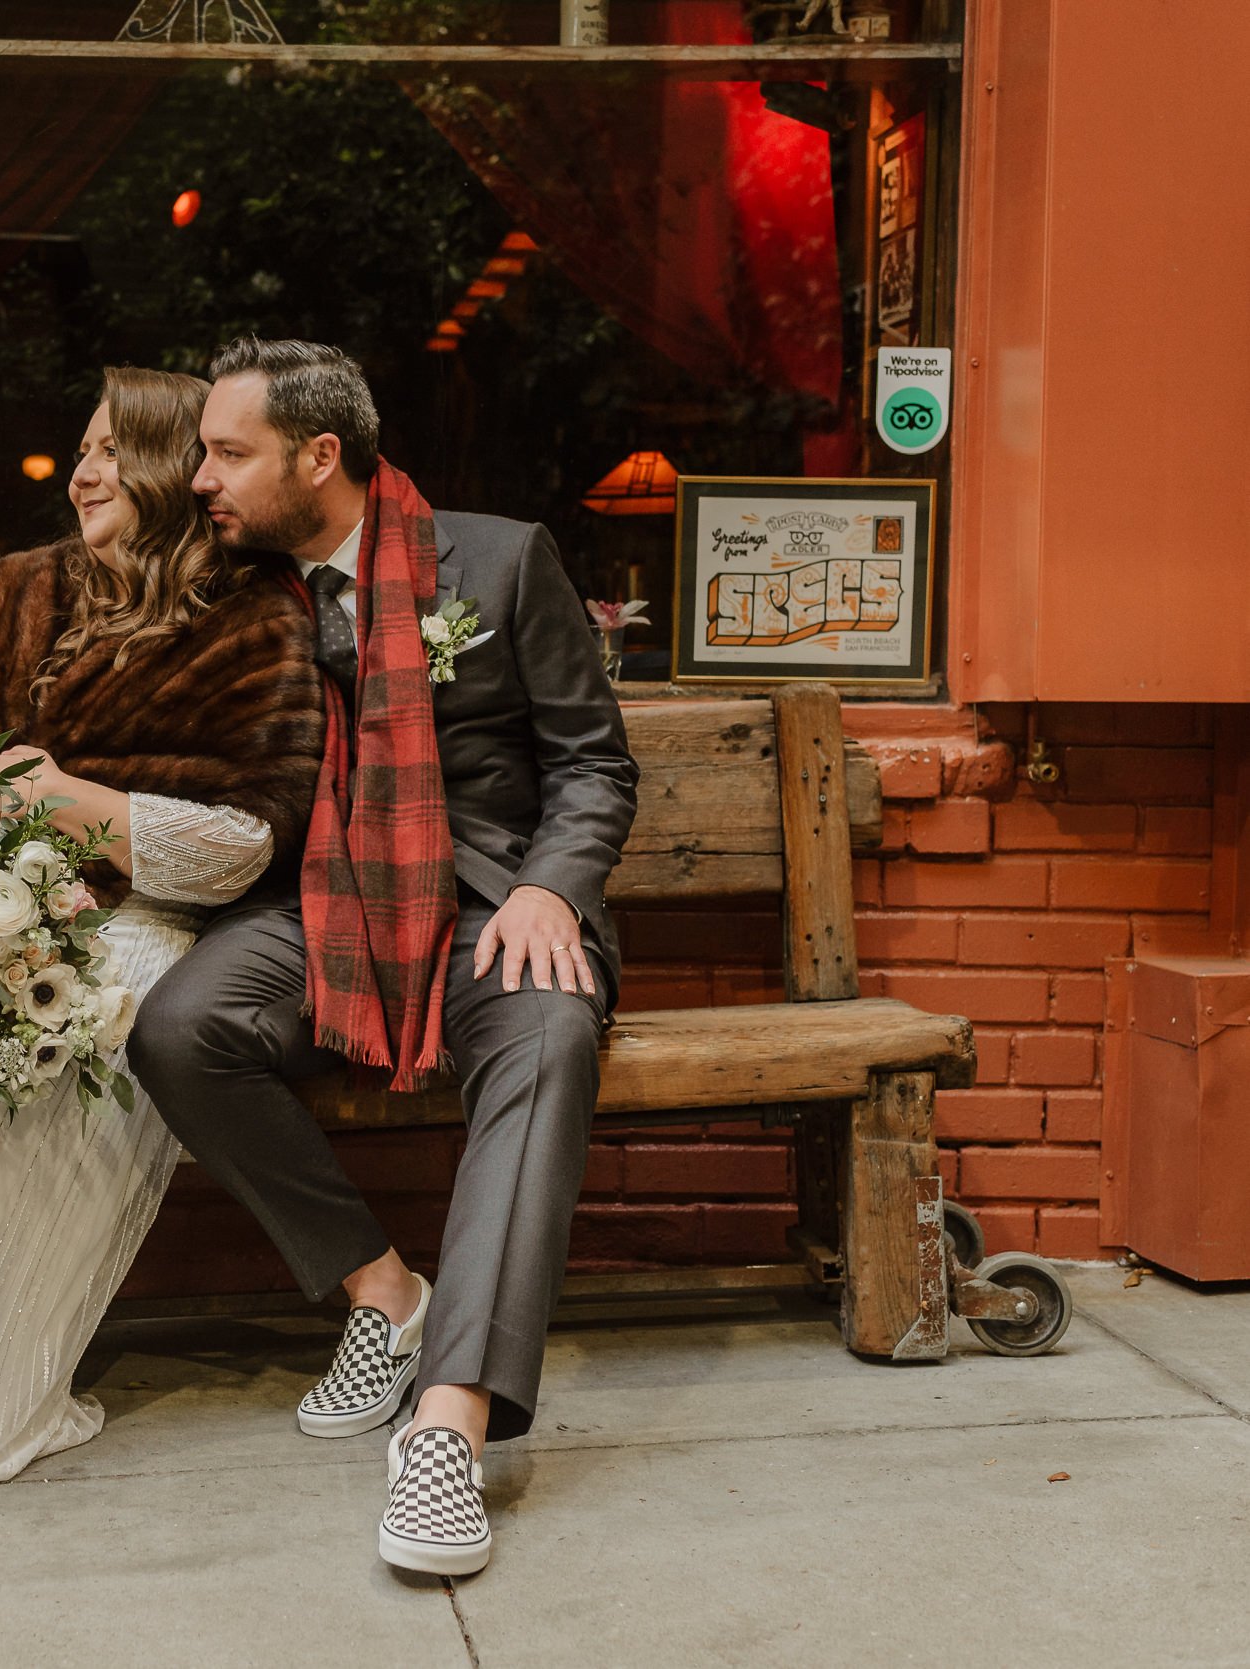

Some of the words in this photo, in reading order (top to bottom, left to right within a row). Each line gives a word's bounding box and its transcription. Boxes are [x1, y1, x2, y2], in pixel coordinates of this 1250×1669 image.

[890, 356, 922, 366] We're
[924, 358, 938, 366] on
[883, 365, 944, 378] Tripadvisor
[711, 527, 769, 552] Greetings
[724, 546, 748, 562] from
[706, 559, 904, 647] SPECS
[845, 637, 872, 645] NORTH
[873, 637, 901, 645] BEACH
